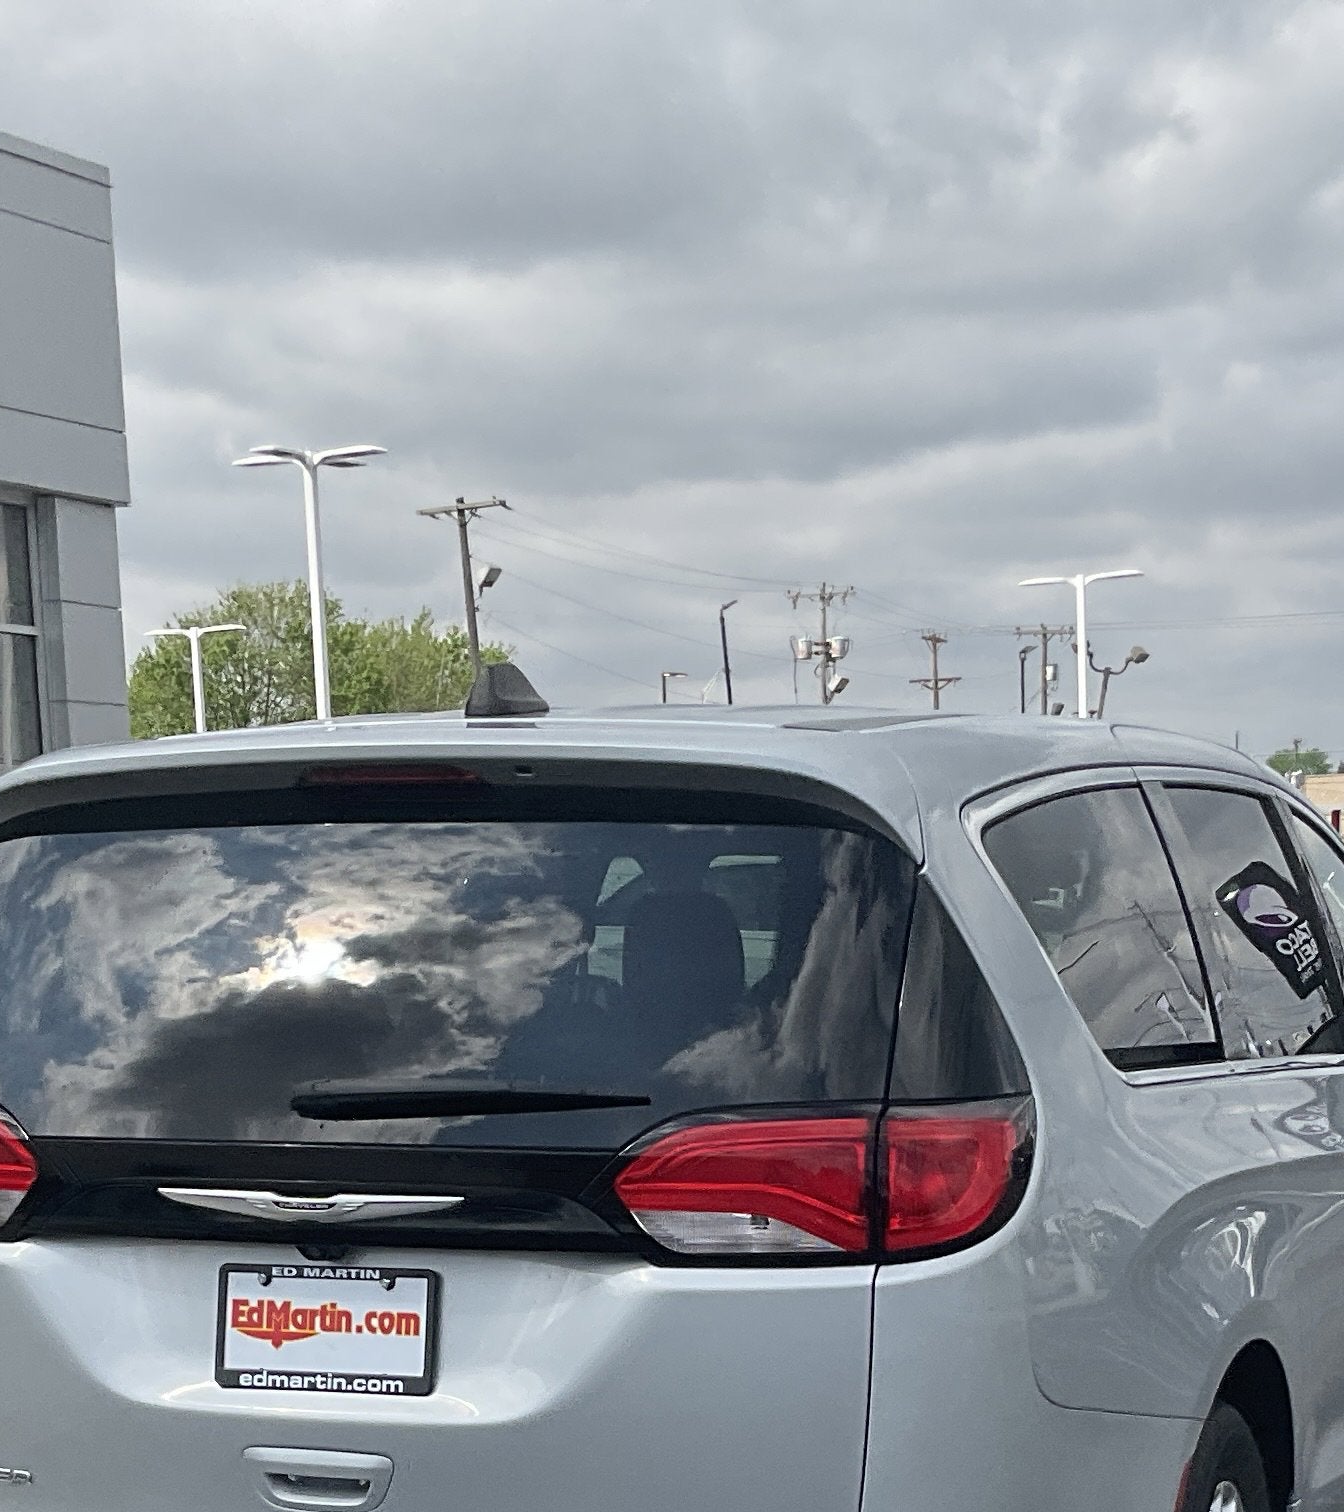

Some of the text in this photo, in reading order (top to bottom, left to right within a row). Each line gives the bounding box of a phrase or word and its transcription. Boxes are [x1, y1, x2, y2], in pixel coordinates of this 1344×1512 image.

[271, 1266, 381, 1280] ED MARTIN
[230, 1298, 421, 1338] EdMartin.com
[238, 1368, 404, 1394] edmartin.com
